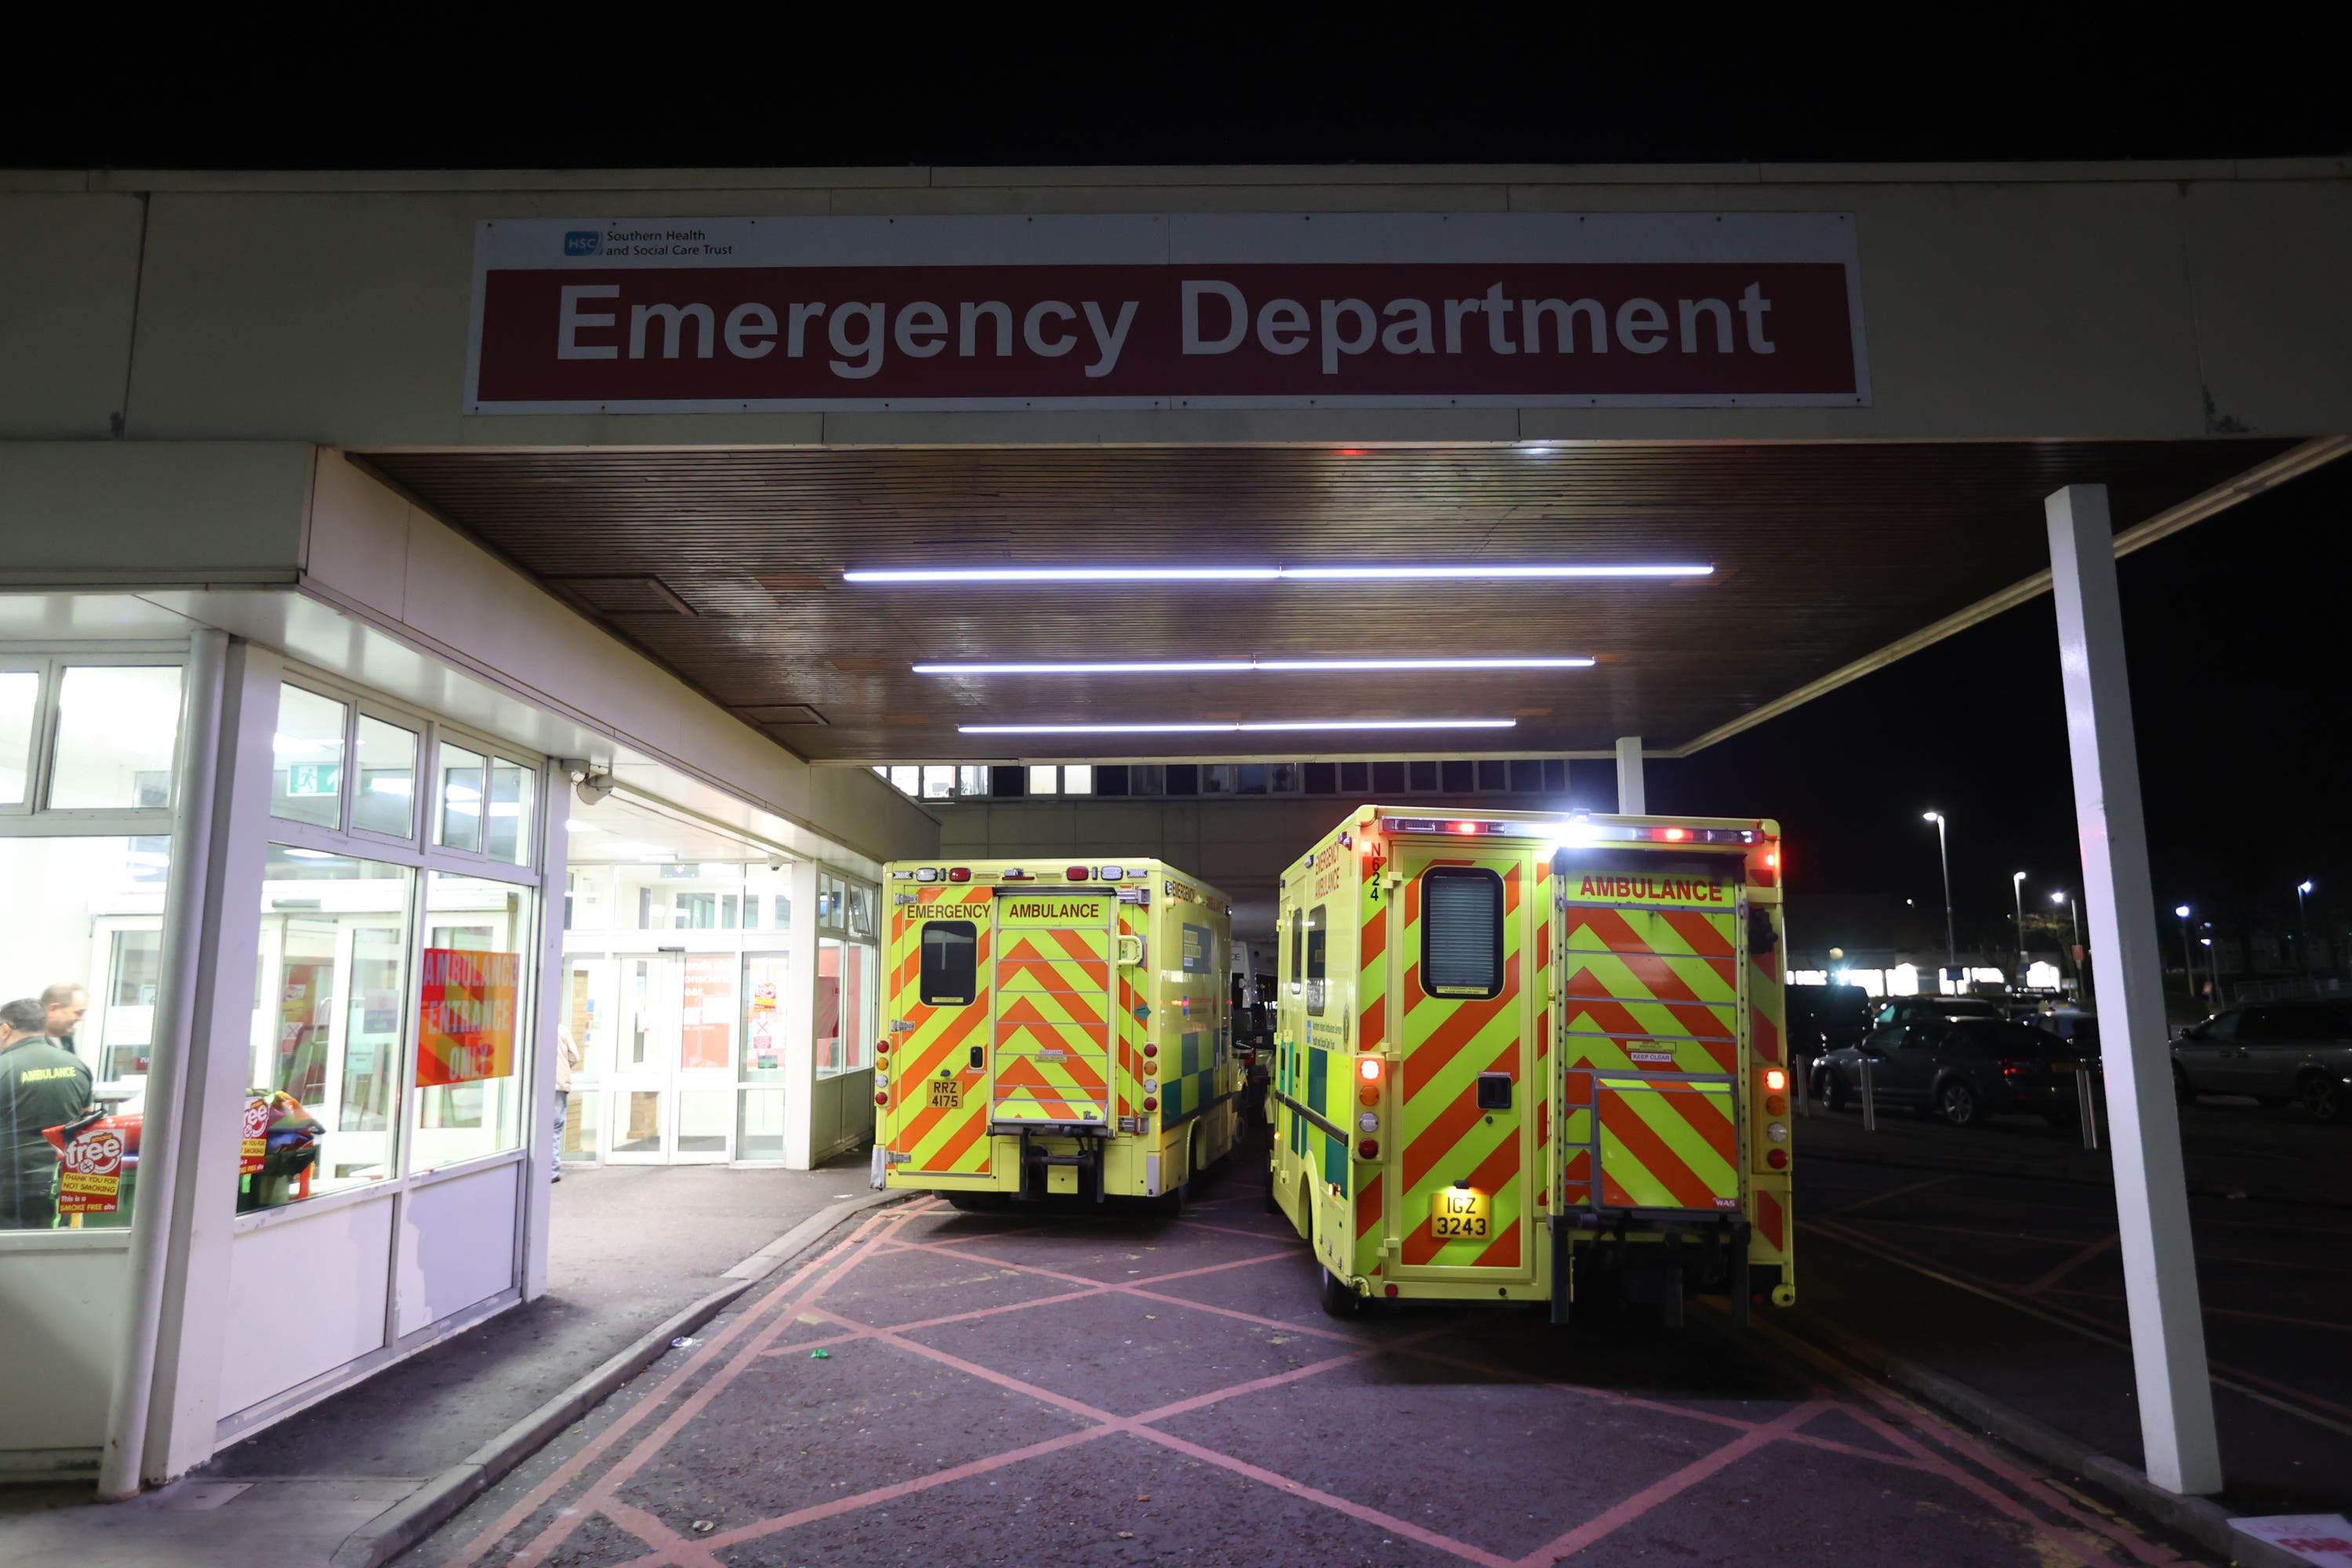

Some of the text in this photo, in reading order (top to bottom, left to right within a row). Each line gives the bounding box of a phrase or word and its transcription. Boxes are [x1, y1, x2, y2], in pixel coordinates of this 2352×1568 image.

[568, 238, 596, 249] HSC
[607, 230, 706, 241] Southern Health
[606, 245, 733, 256] and Social Care Trust
[557, 279, 1776, 379] Emergency Department
[1581, 875, 1722, 902] AMBULANCE
[907, 904, 1099, 919] EMERGENCY AMBULANCE
[1231, 953, 1240, 961] CE
[423, 952, 520, 987] AMBULANCE
[427, 1000, 510, 1035] ENTRANCE
[449, 1044, 489, 1080] ONLY
[21, 1066, 77, 1083] AMBULANCE
[934, 1082, 956, 1093] RRZ
[932, 1095, 958, 1107] 4175
[245, 1105, 267, 1125] ree
[66, 1139, 120, 1165] free
[81, 1184, 115, 1193] SMOKING
[1447, 1196, 1476, 1214] IGZ
[1437, 1217, 1486, 1236] 3243
